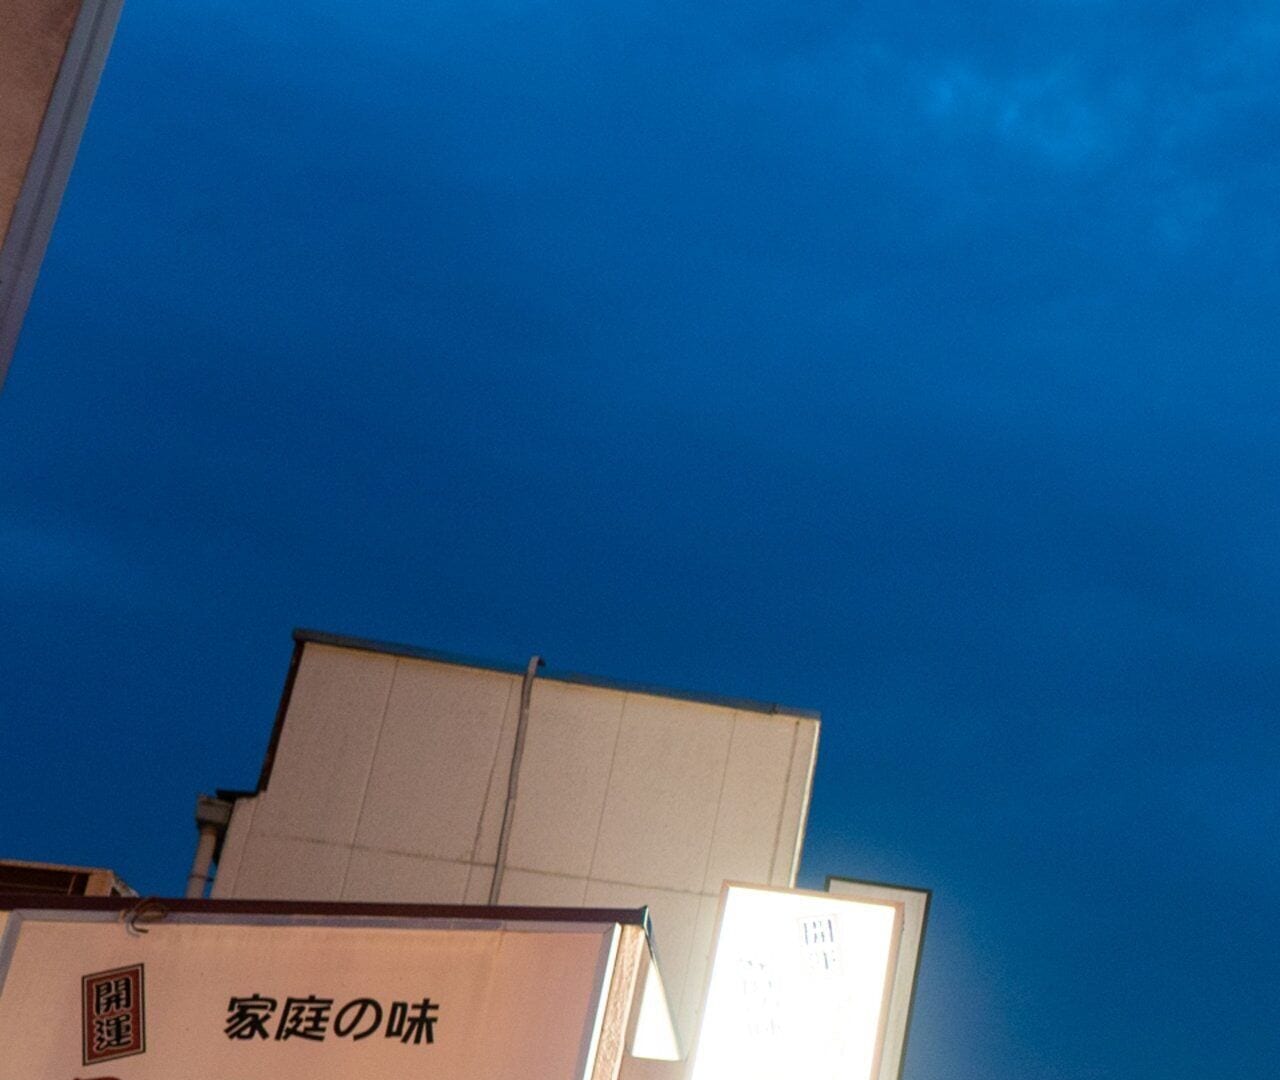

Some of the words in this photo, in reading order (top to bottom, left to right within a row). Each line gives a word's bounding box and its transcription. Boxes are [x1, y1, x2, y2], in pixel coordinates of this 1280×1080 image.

[94, 976, 133, 1052] 開運
[223, 993, 440, 1045] 家庭の味
